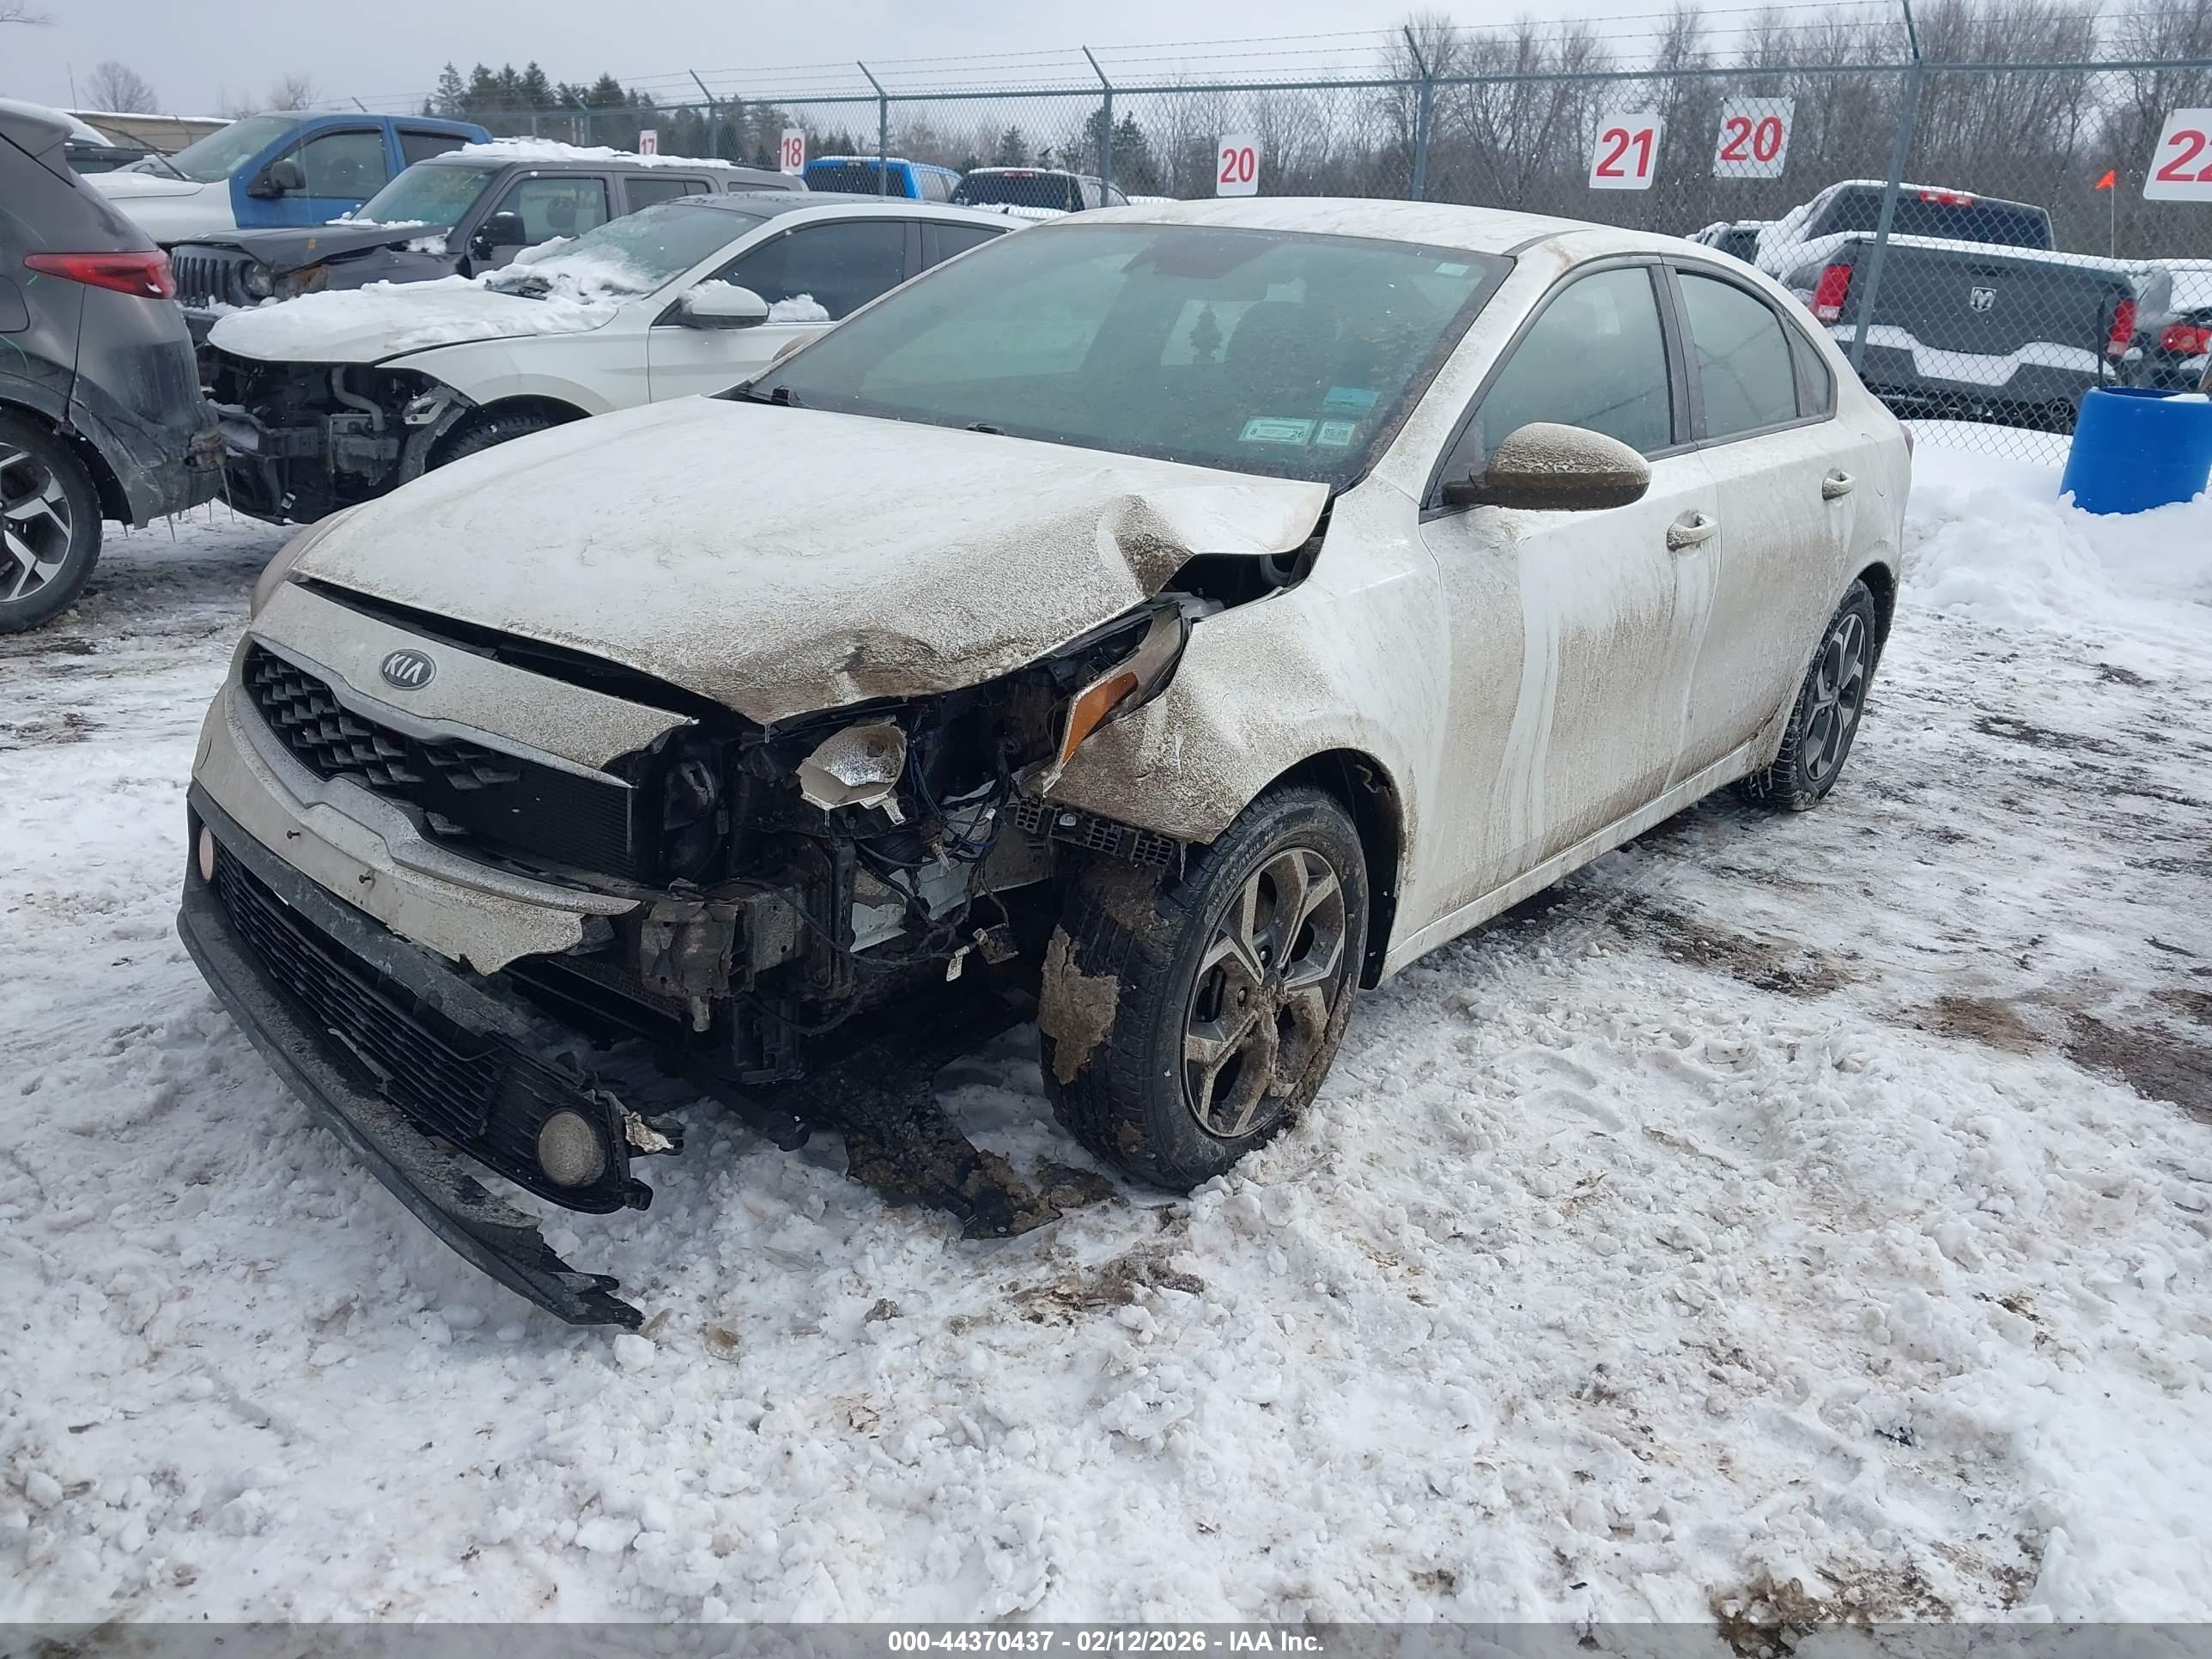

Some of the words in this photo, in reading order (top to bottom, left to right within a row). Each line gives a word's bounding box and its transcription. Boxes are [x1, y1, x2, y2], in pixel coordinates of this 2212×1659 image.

[641, 138, 654, 155] 17
[783, 137, 802, 167] 18
[1596, 128, 1653, 177] 21
[1720, 117, 1783, 161] 20
[1220, 148, 1255, 183] 20
[384, 653, 424, 684] KIA
